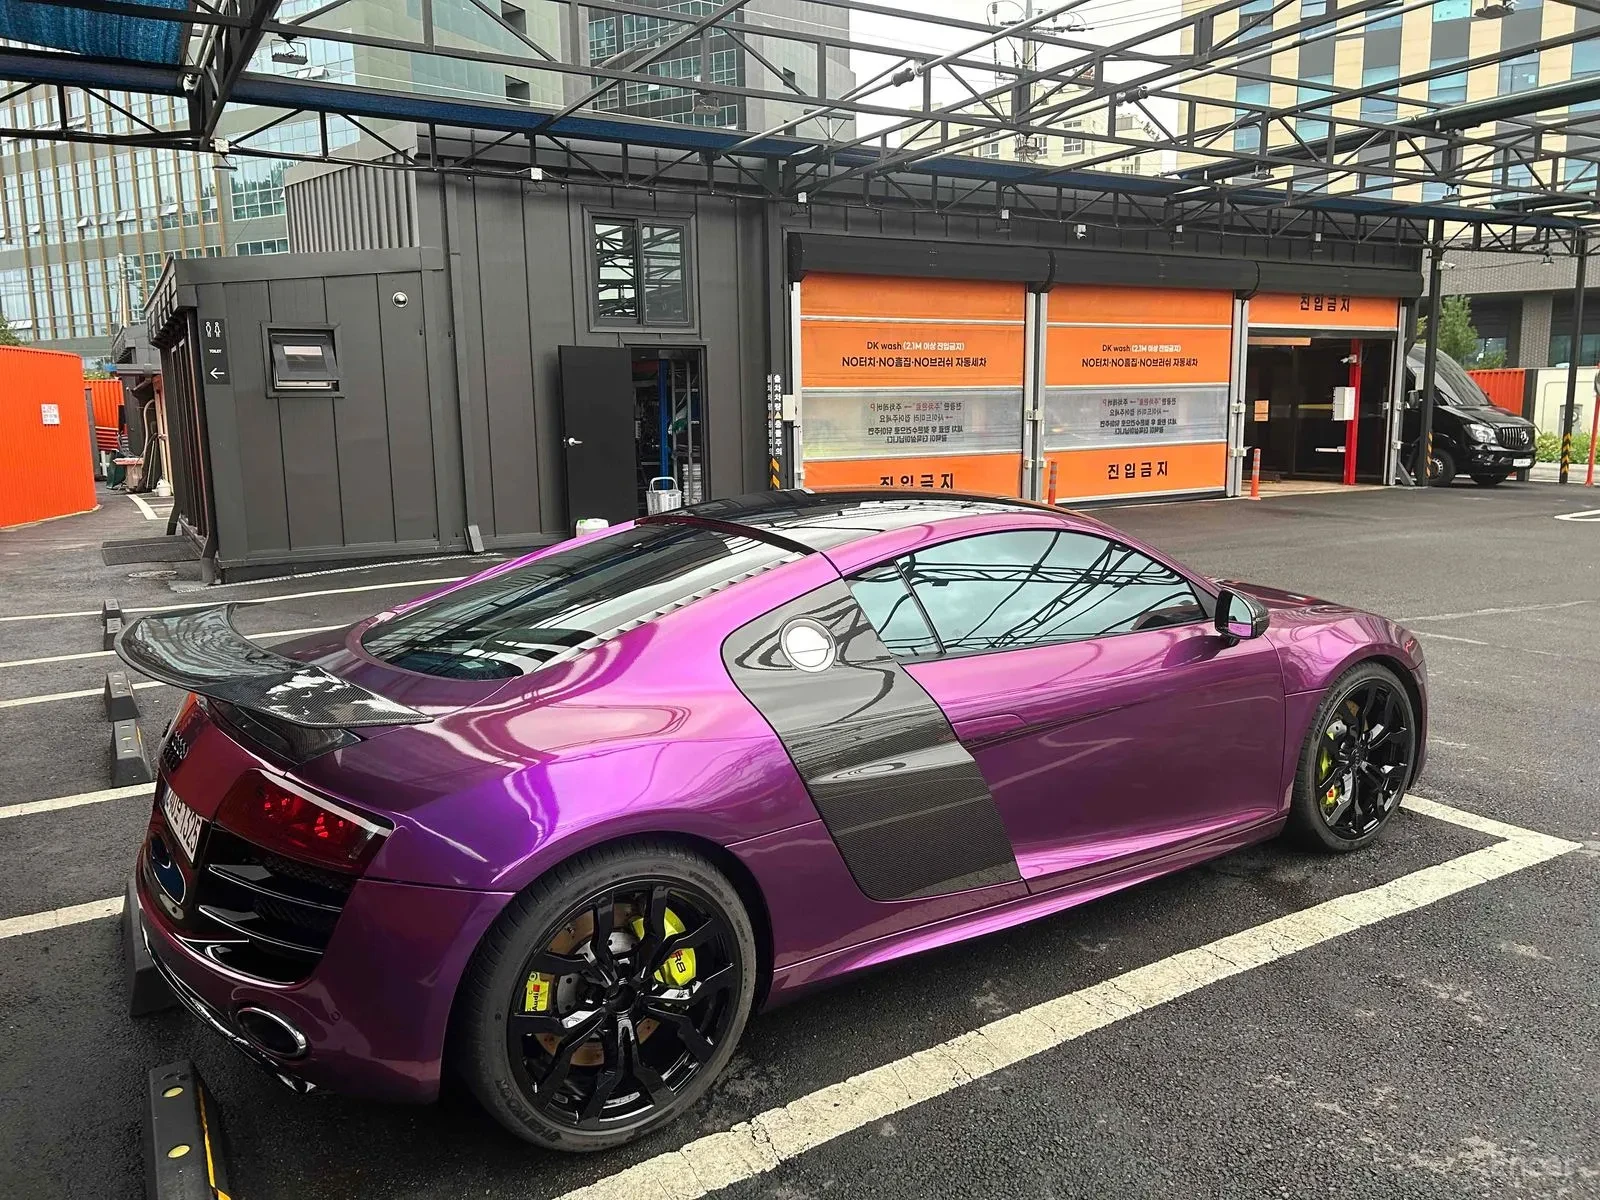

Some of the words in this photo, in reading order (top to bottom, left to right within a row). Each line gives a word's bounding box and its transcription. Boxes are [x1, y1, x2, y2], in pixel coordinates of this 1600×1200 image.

[1300, 293, 1350, 312] 진입금지
[867, 341, 879, 350] DK
[881, 341, 902, 350] wash
[1102, 344, 1112, 352] DK
[1113, 344, 1131, 352] wash
[955, 357, 987, 367] 자동세차
[1172, 357, 1198, 367] 자동세차
[1108, 460, 1168, 480] 진입금지
